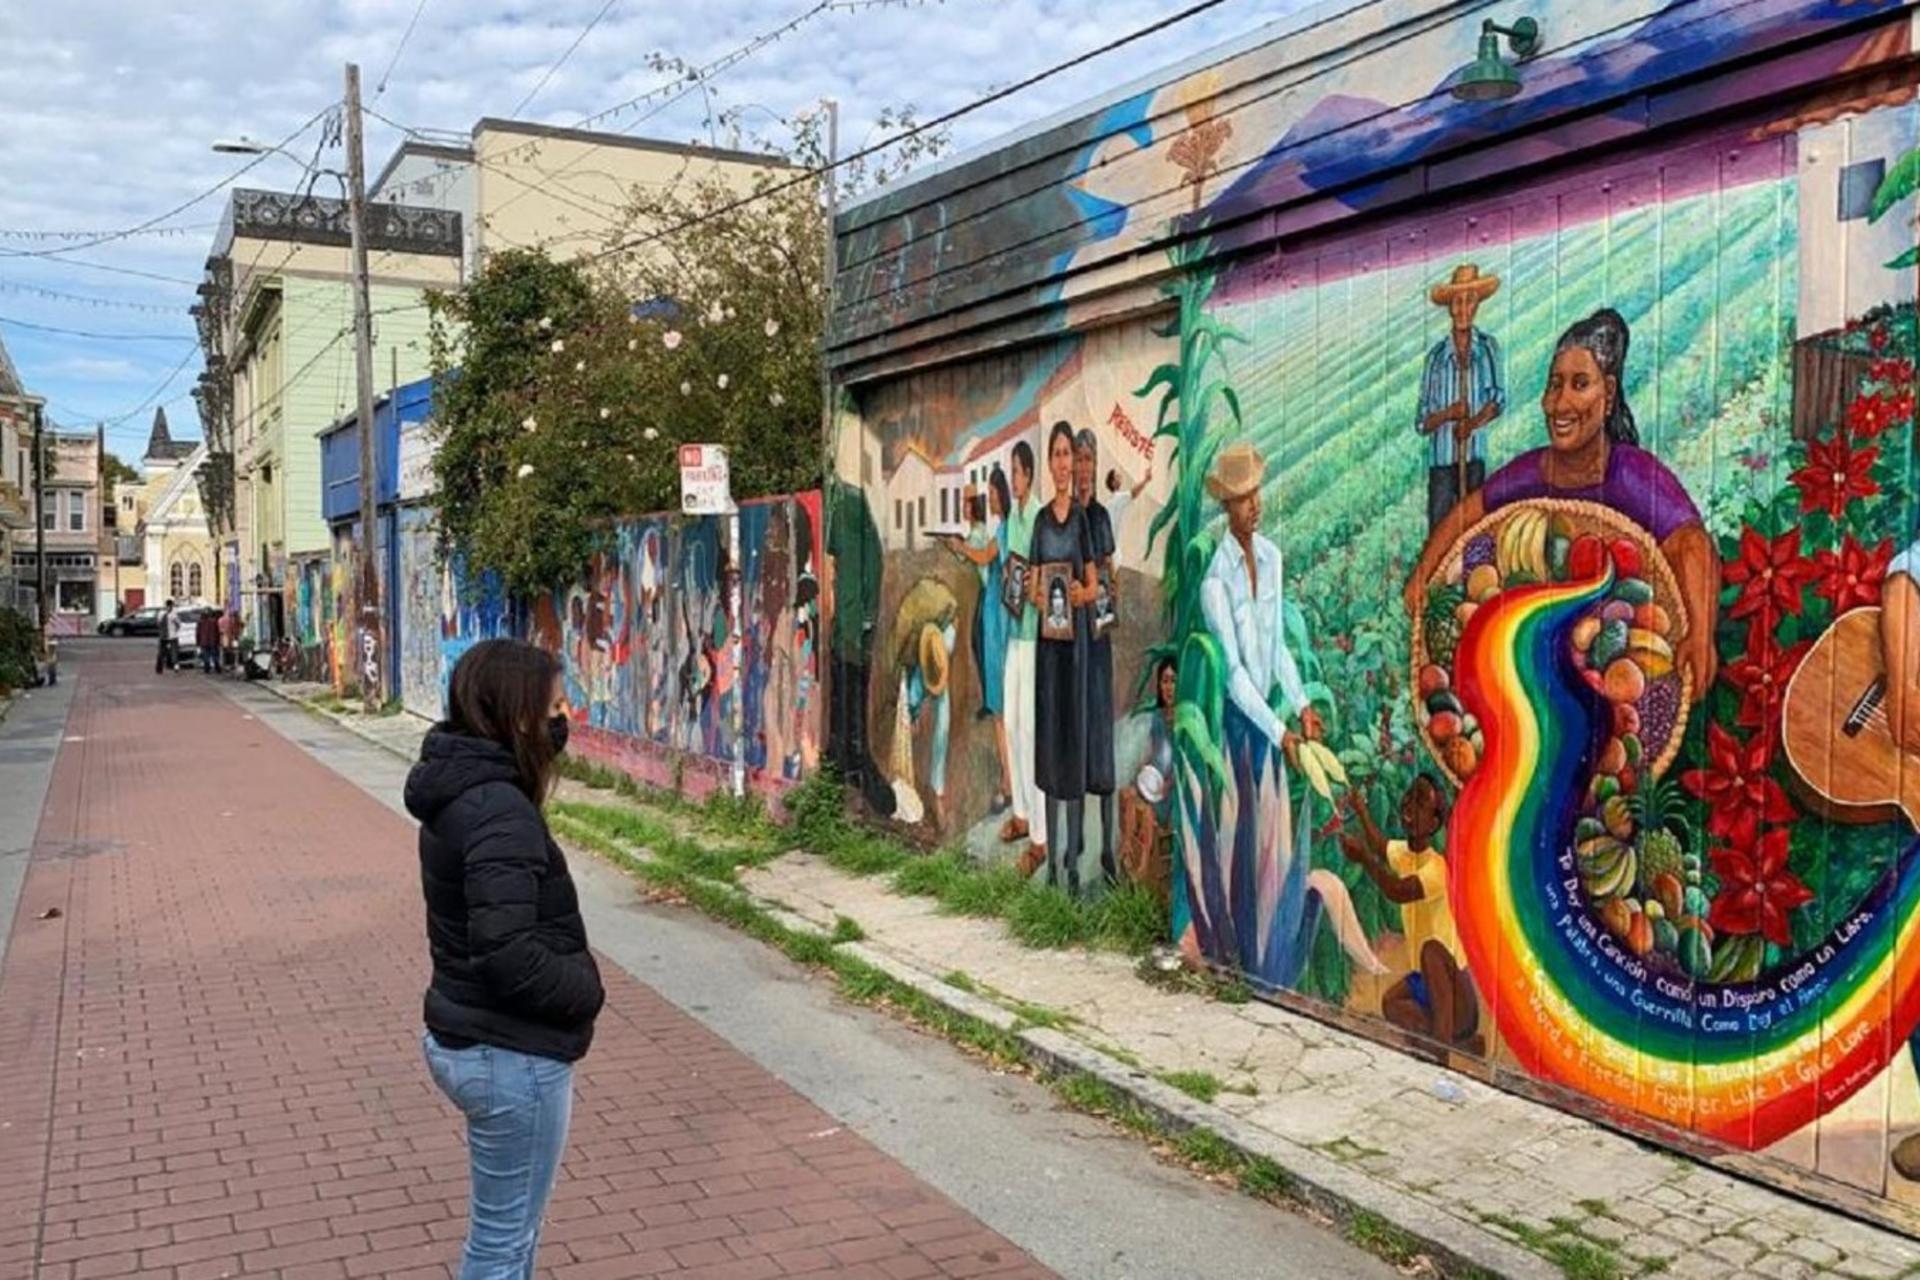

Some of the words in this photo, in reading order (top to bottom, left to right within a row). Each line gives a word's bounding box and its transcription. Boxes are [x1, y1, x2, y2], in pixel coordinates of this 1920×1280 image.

[684, 450, 700, 466] NO
[1107, 402, 1155, 460] RESISTE
[1545, 883, 1559, 911] una
[1604, 972, 1625, 997] una
[1630, 988, 1692, 1029] Guerrilla
[1701, 1013, 1740, 1032] Como
[1778, 999, 1795, 1015] el
[1578, 915, 1596, 939] una
[1699, 993, 1717, 1009] un
[1723, 988, 1776, 1012] Disparo
[1778, 1071, 1792, 1090] I
[1836, 1020, 1871, 1053] Love
